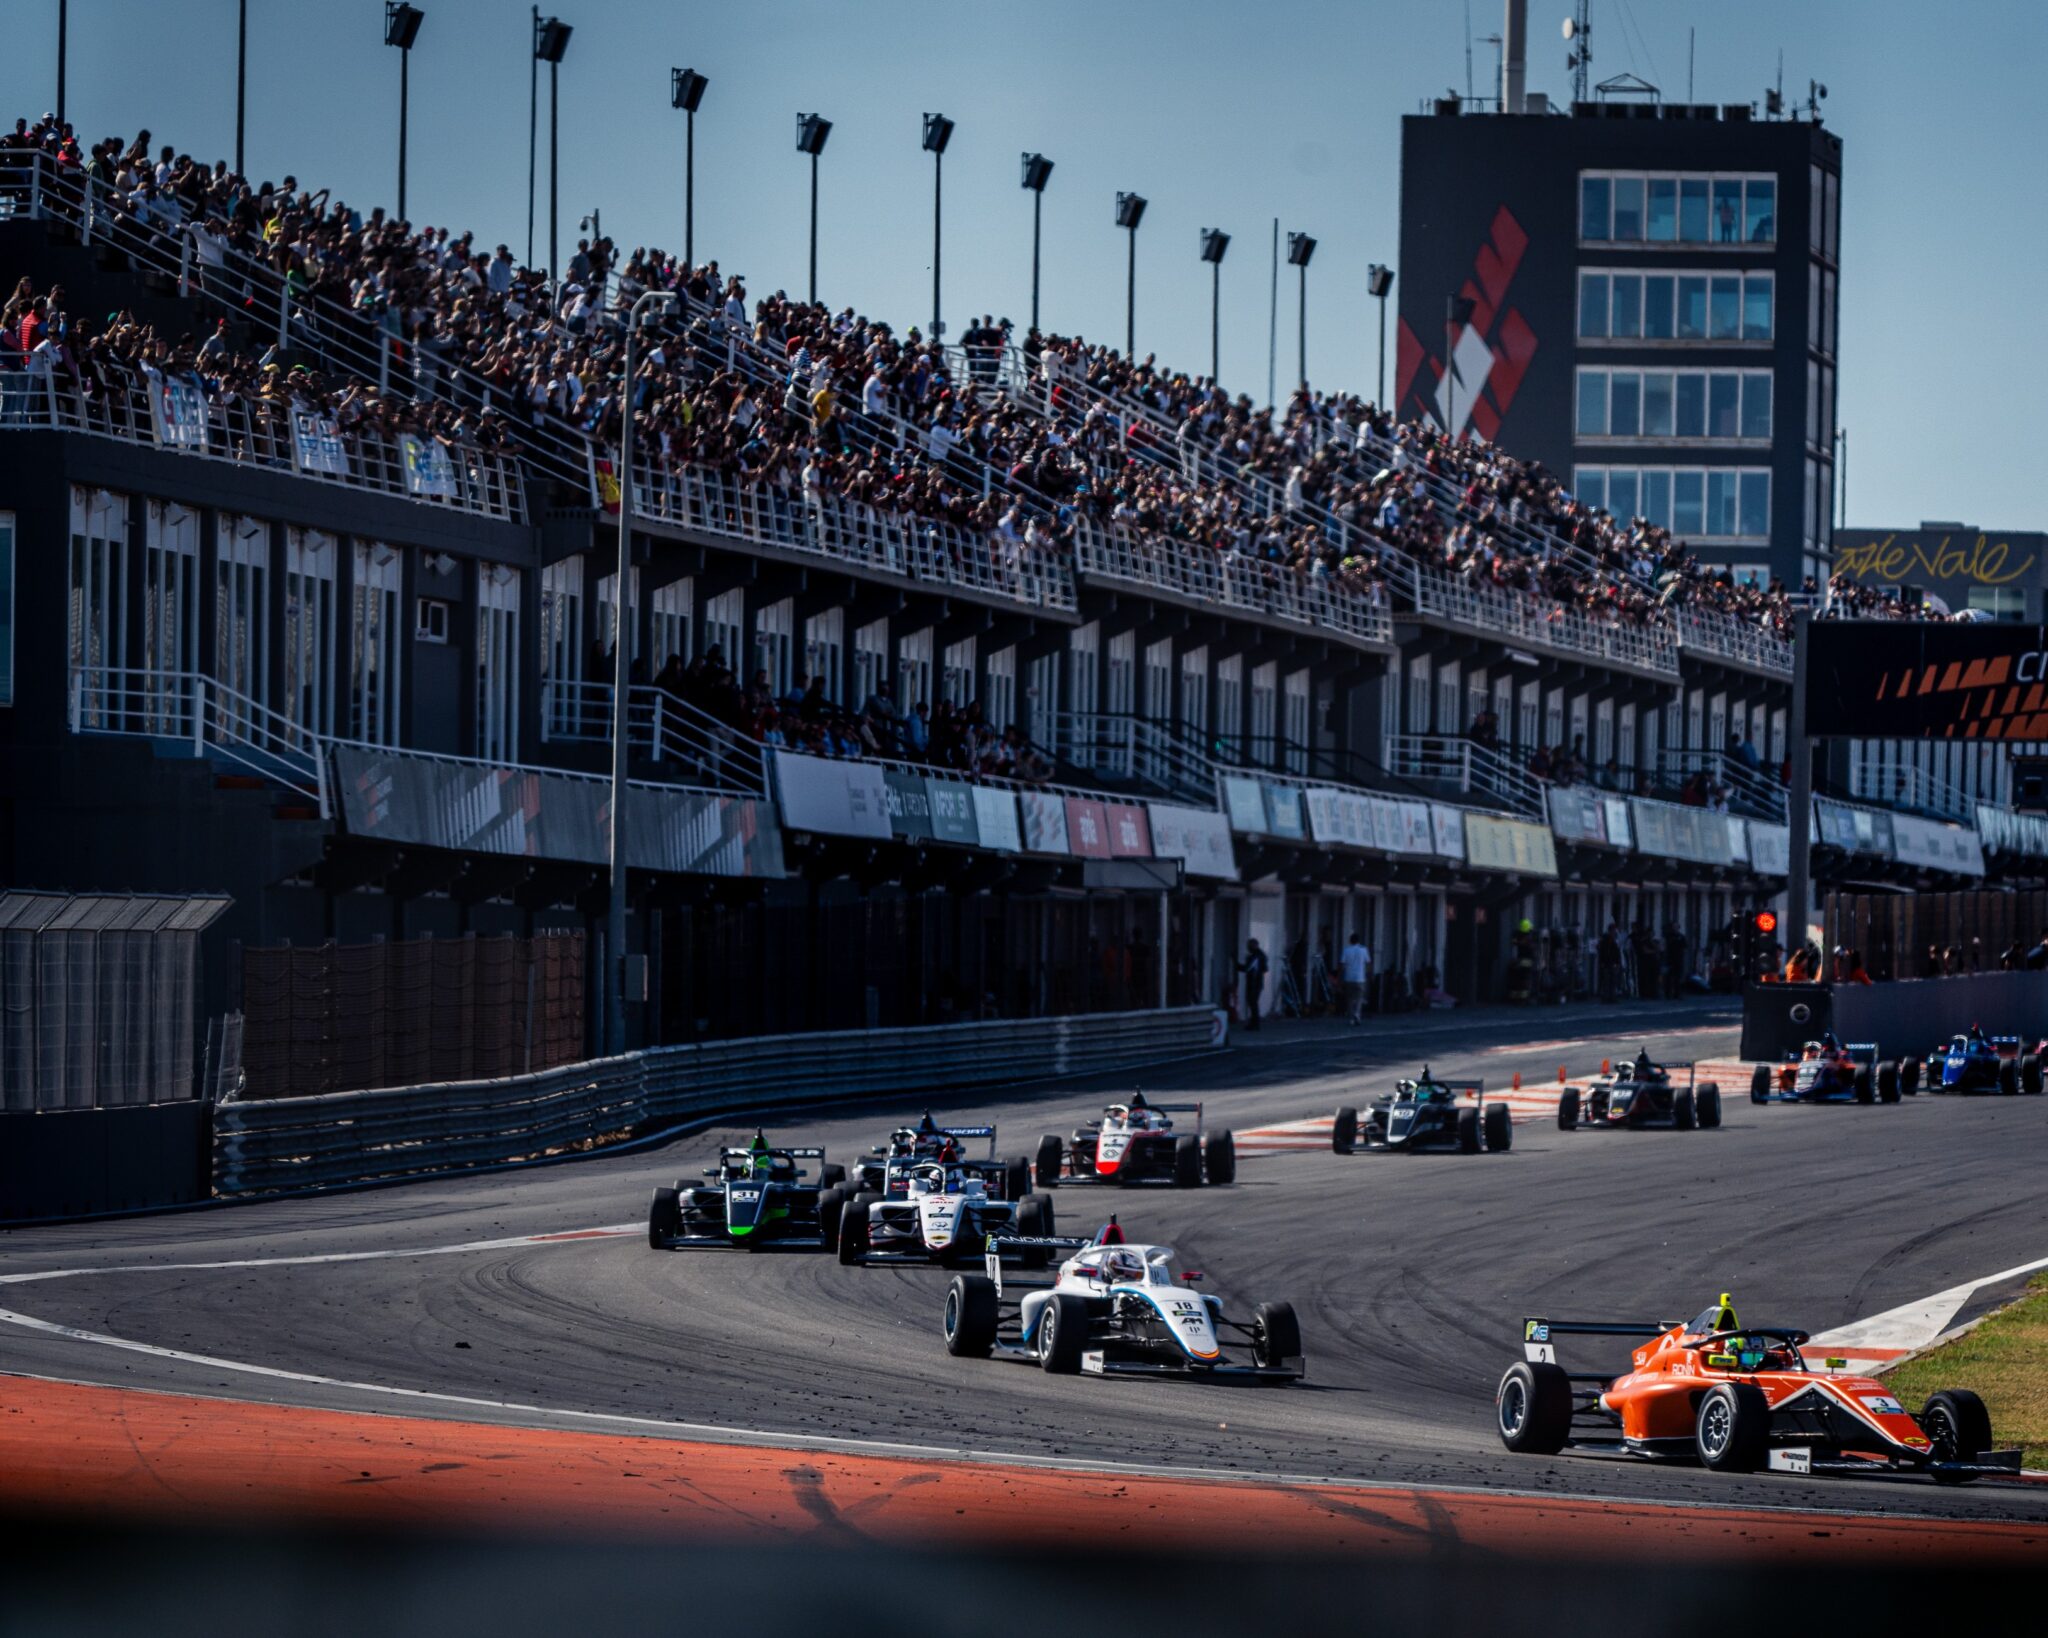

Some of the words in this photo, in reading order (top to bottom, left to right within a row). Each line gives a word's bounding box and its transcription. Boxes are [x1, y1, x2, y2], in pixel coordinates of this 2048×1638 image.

[1912, 534, 2036, 584] Vale
[1175, 1302, 1193, 1310] 18
[1672, 1363, 1695, 1376] RONIN
[1875, 1397, 1889, 1407] 3
